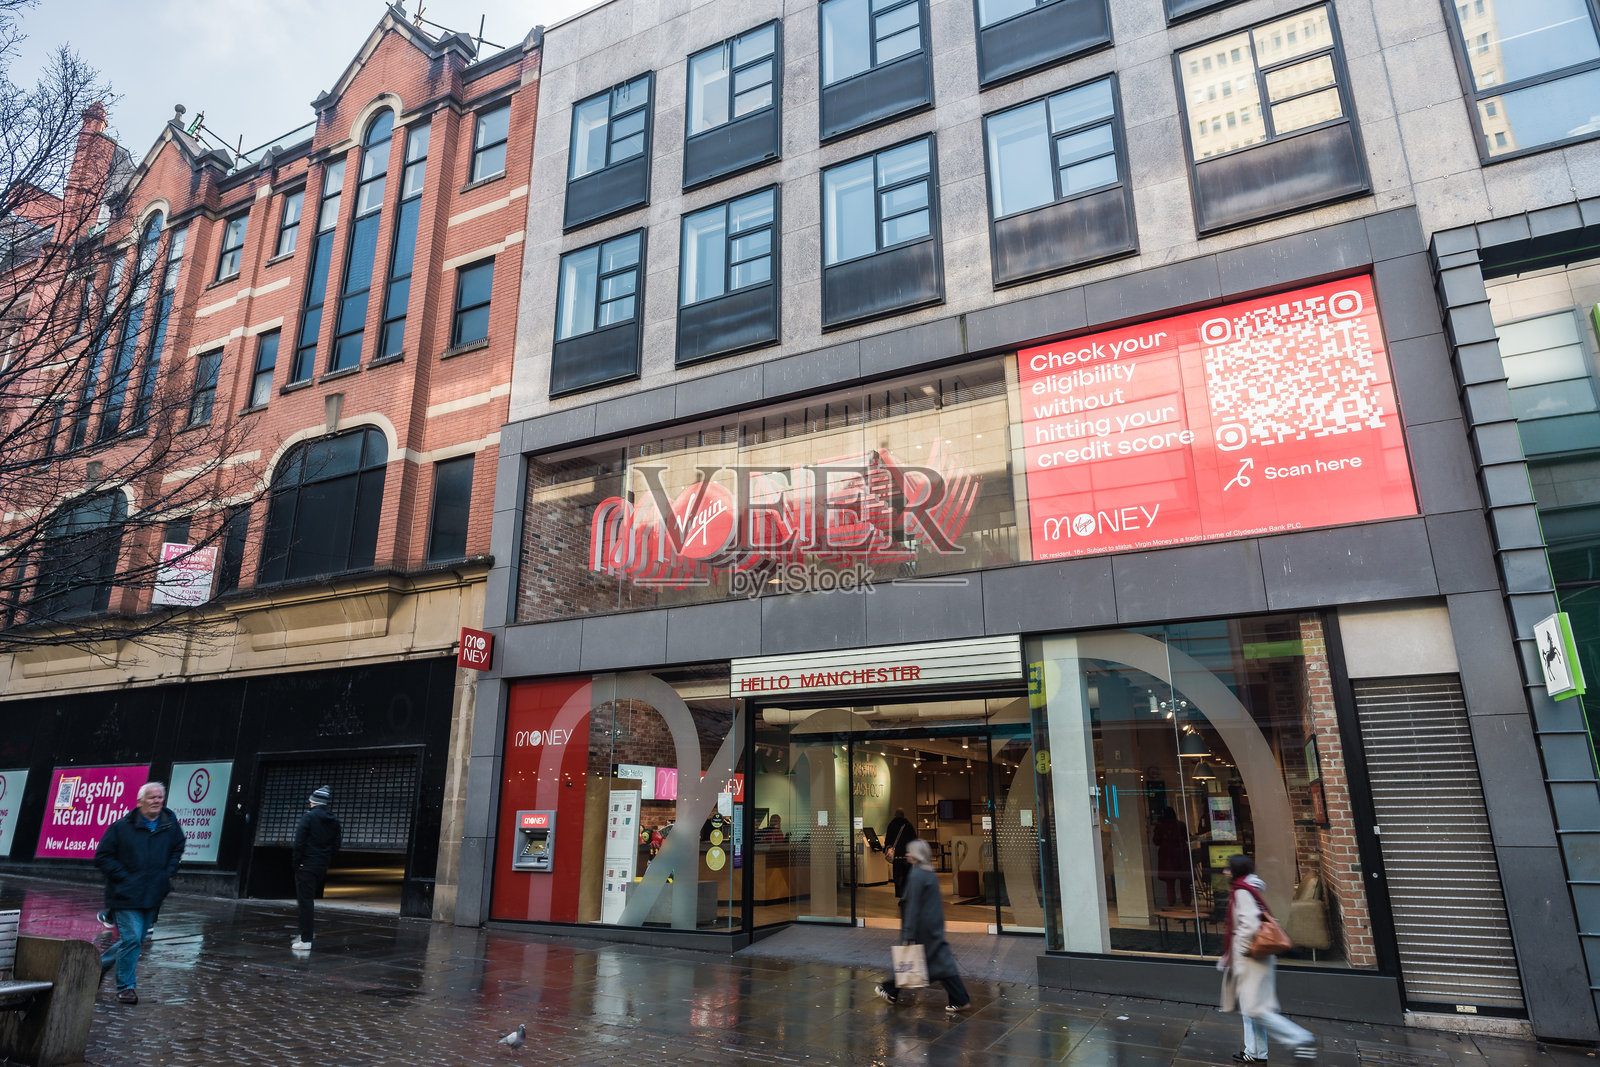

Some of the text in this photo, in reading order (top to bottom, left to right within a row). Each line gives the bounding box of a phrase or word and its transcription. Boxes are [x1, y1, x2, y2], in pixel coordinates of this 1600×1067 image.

[1030, 332, 1167, 371] Check your
[1032, 363, 1136, 395] eligibility
[1033, 388, 1125, 419] without
[1035, 406, 1175, 444] hitting your
[1038, 429, 1195, 467] credit score
[1264, 457, 1362, 479] Scan here
[1086, 546, 1107, 554] Subject
[1152, 538, 1173, 546] Money
[1233, 526, 1268, 536] Clydesdale
[740, 665, 921, 692] HELLO MANCHESTER
[75, 776, 125, 804] lagship
[52, 803, 95, 826] Retail
[178, 817, 210, 827] AMES FOX
[45, 837, 63, 850] New
[64, 837, 87, 850] Lease
[197, 831, 212, 840] 8089
